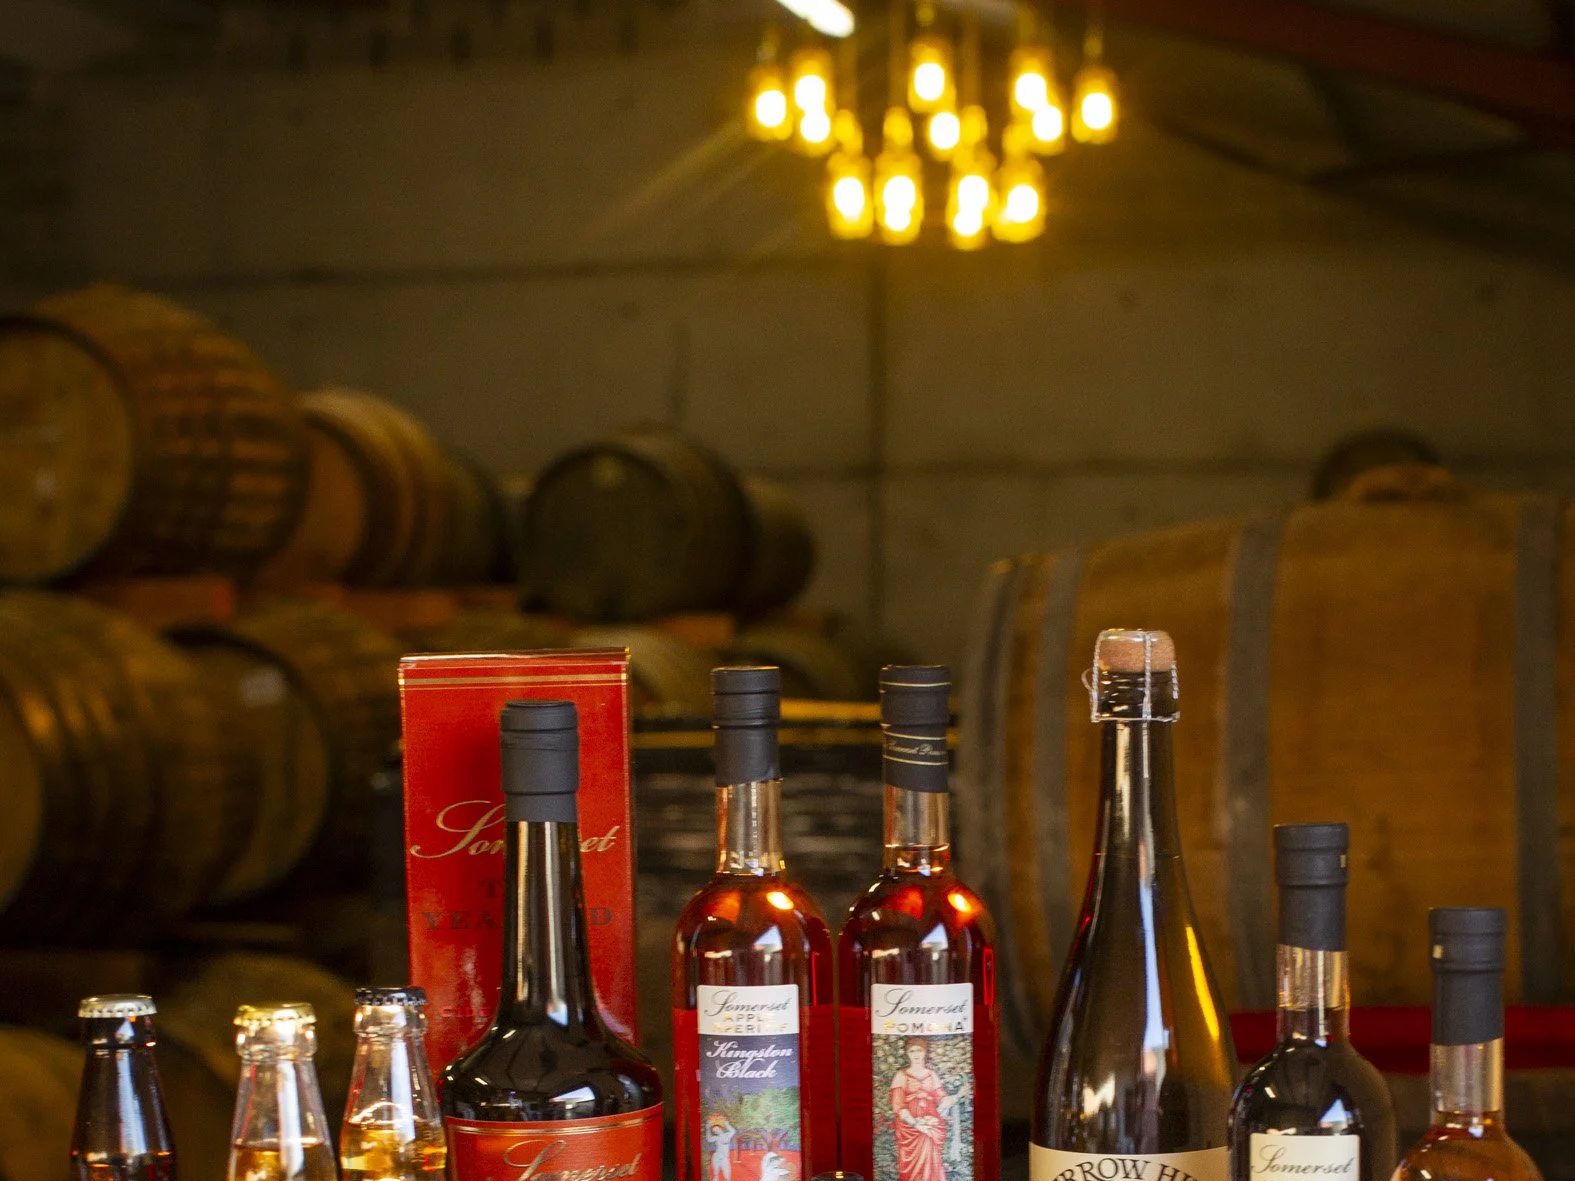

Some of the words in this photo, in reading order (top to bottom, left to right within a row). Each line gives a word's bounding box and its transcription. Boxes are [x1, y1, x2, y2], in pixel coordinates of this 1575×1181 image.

[420, 910, 499, 931] YEA
[703, 989, 791, 1017] Somerset
[874, 988, 968, 1017] Somerset
[706, 1039, 794, 1066] Kingston
[714, 1058, 778, 1080] Black
[1251, 1143, 1355, 1175] Somerset
